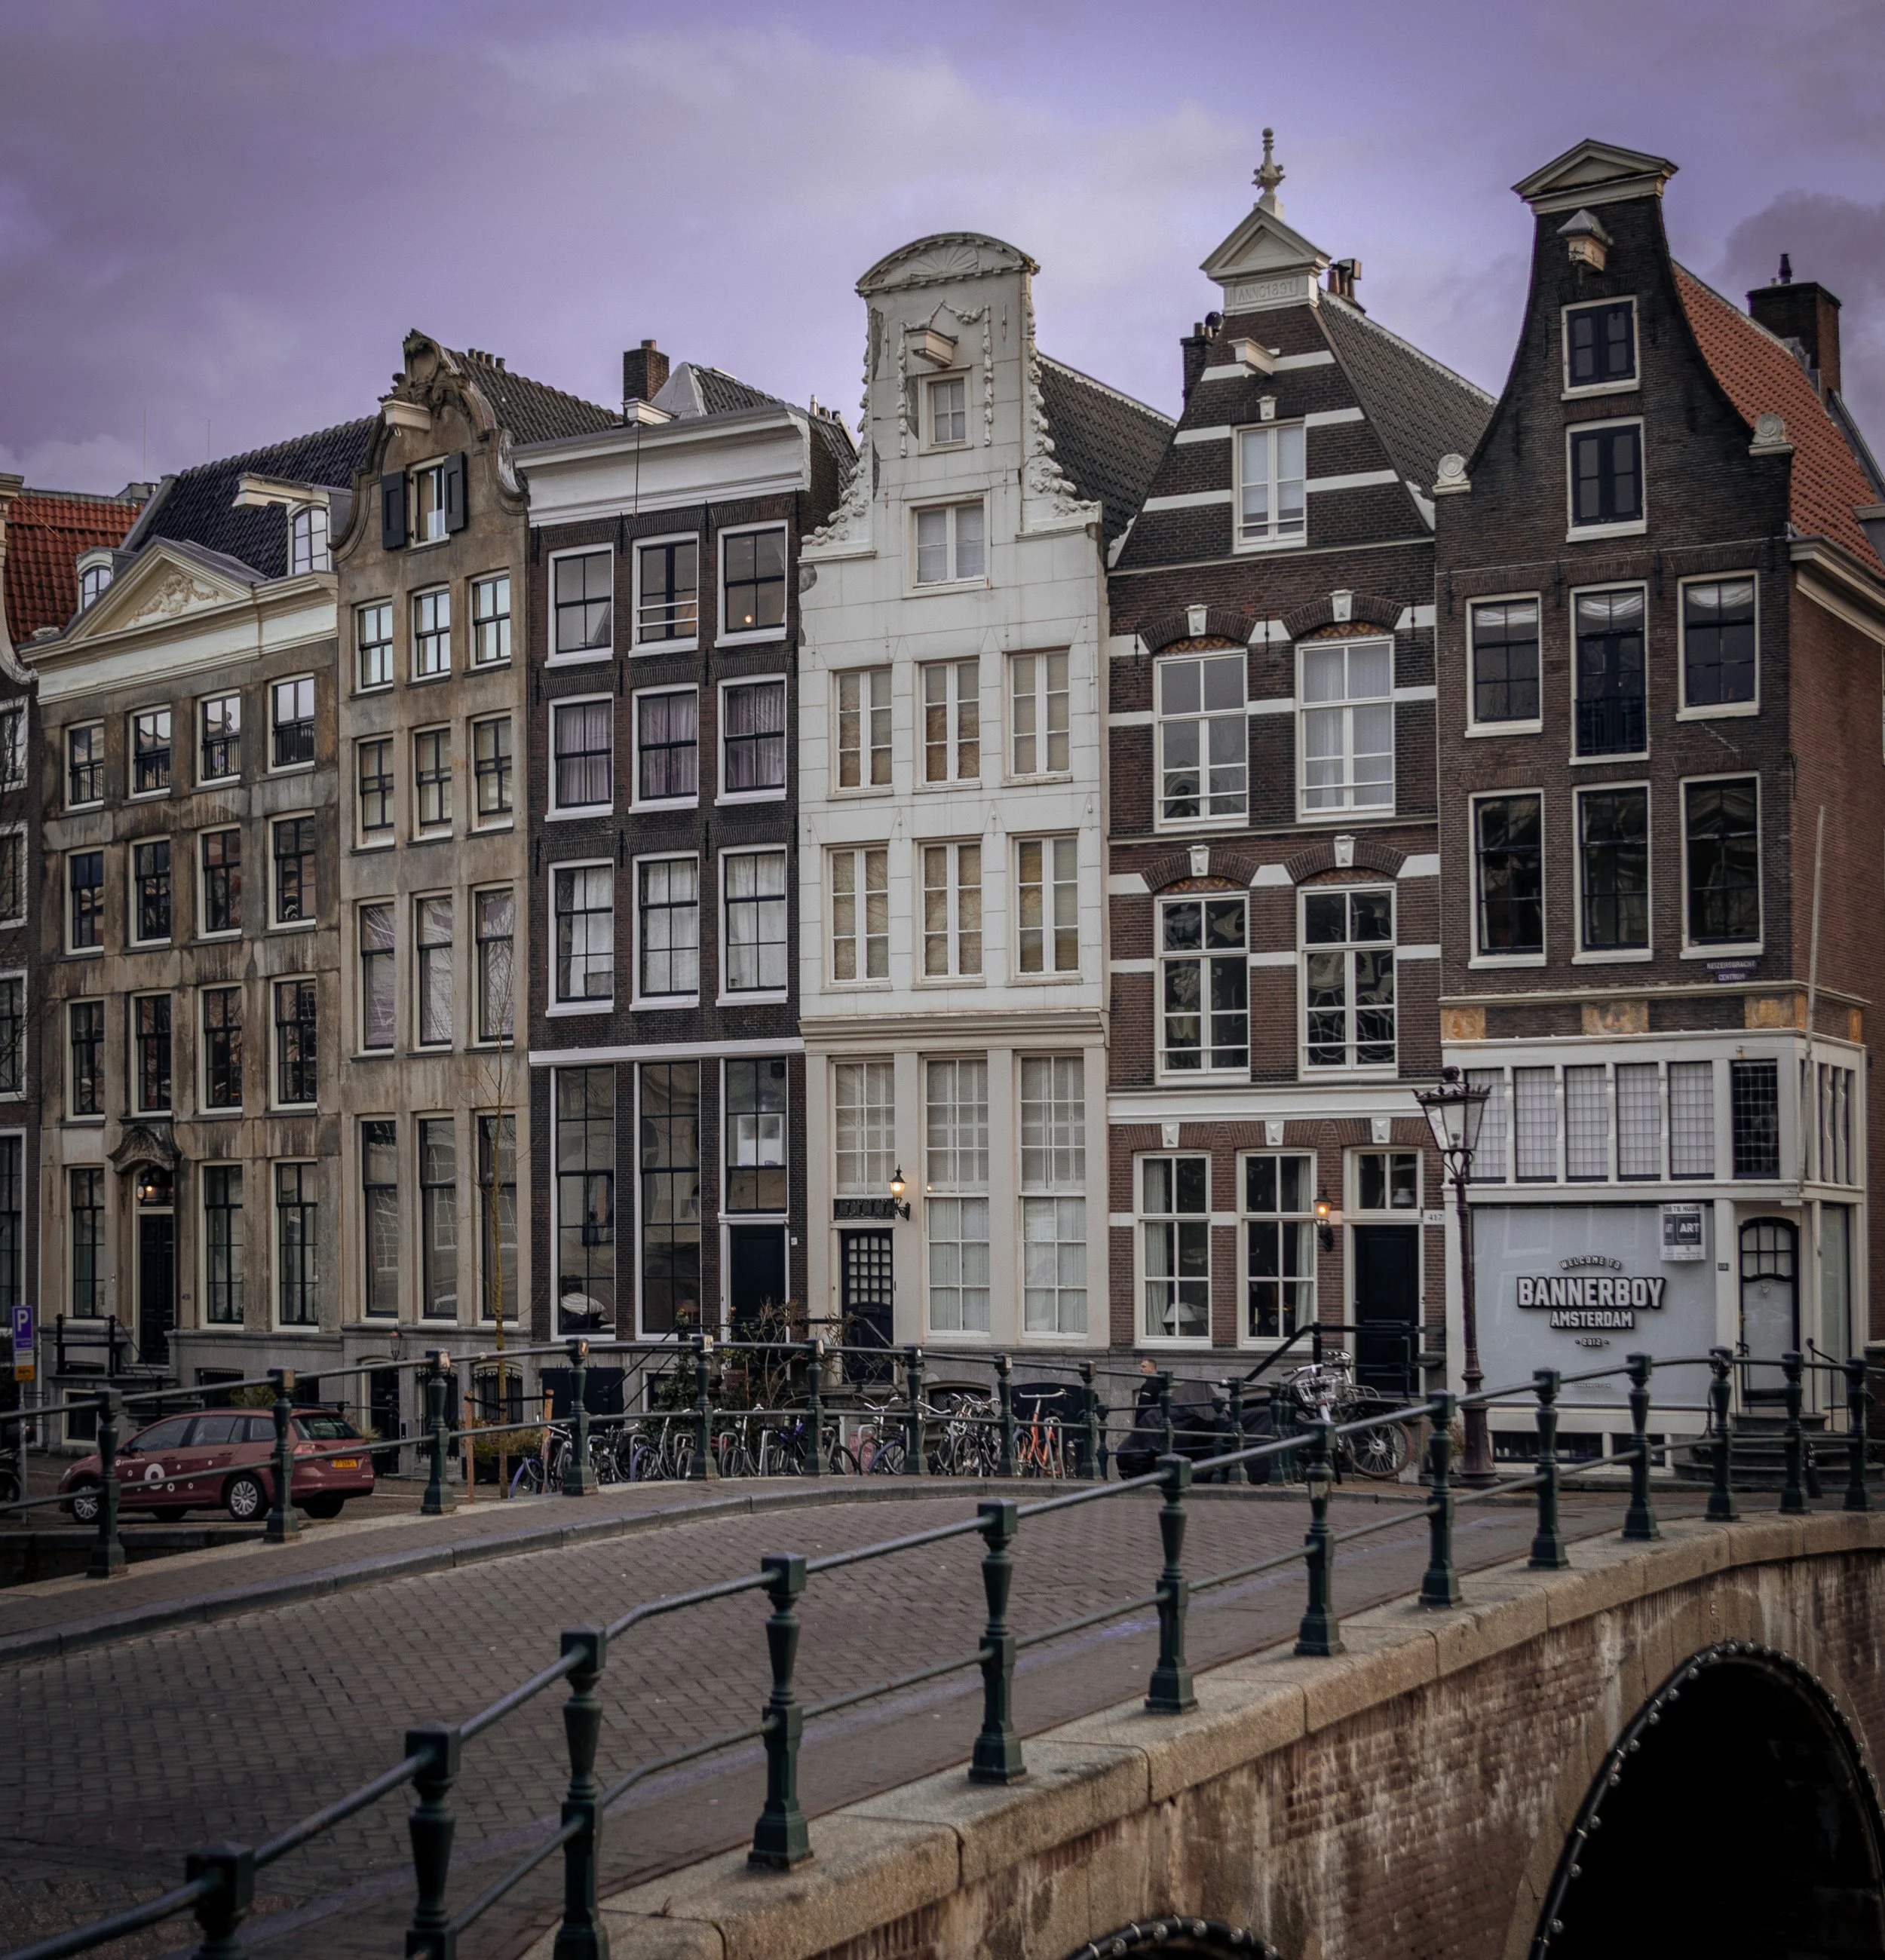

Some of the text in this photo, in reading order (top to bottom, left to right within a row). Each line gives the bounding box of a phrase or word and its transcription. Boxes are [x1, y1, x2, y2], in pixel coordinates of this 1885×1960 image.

[1706, 960, 1755, 969] KEIZERSGRACHT
[1679, 1223, 1700, 1233] ART
[1559, 1255, 1622, 1270] WELCOME TO
[1517, 1277, 1666, 1309] BANNERBOY
[1550, 1310, 1635, 1329] AMSTERDAM
[1581, 1337, 1601, 1346] 2012
